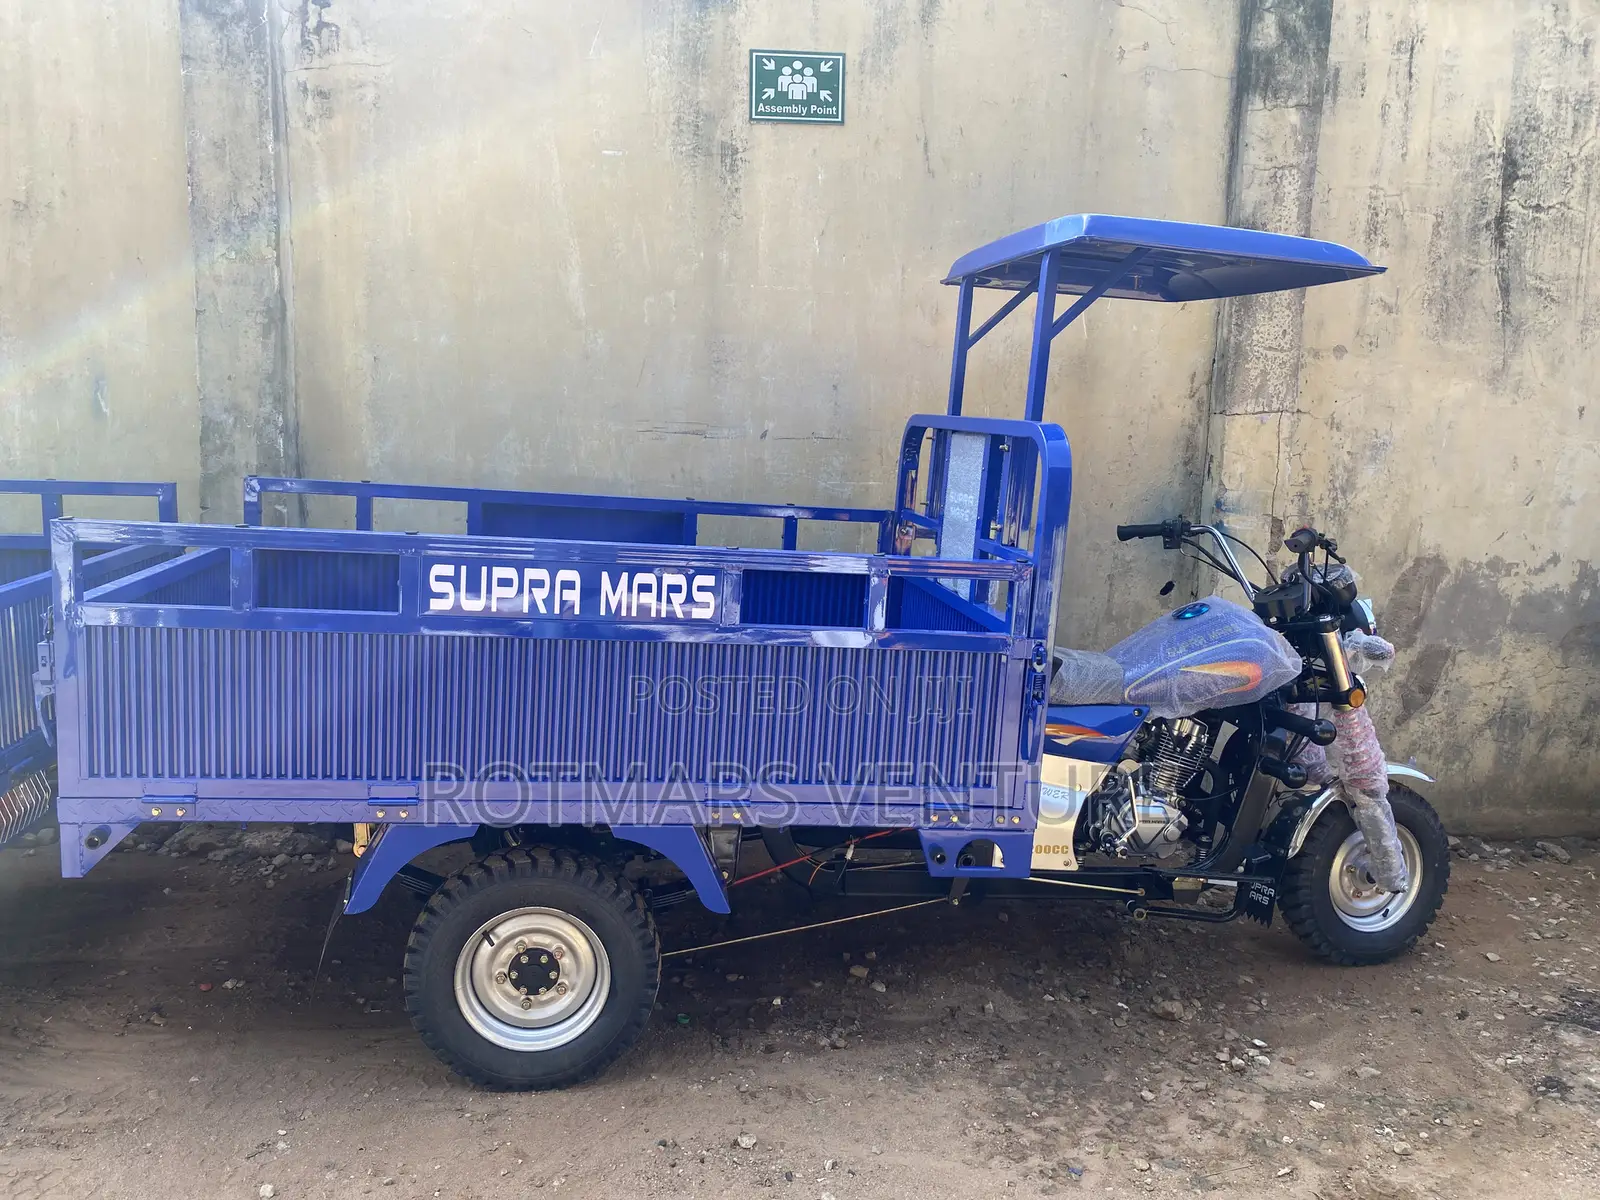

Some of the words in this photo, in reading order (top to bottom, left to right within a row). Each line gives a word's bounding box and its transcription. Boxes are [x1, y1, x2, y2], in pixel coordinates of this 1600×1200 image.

[757, 102, 808, 116] Assembly
[810, 104, 837, 115] Point
[429, 563, 581, 616] SUPRA
[599, 569, 716, 619] MARS
[1033, 844, 1069, 855] 00CC
